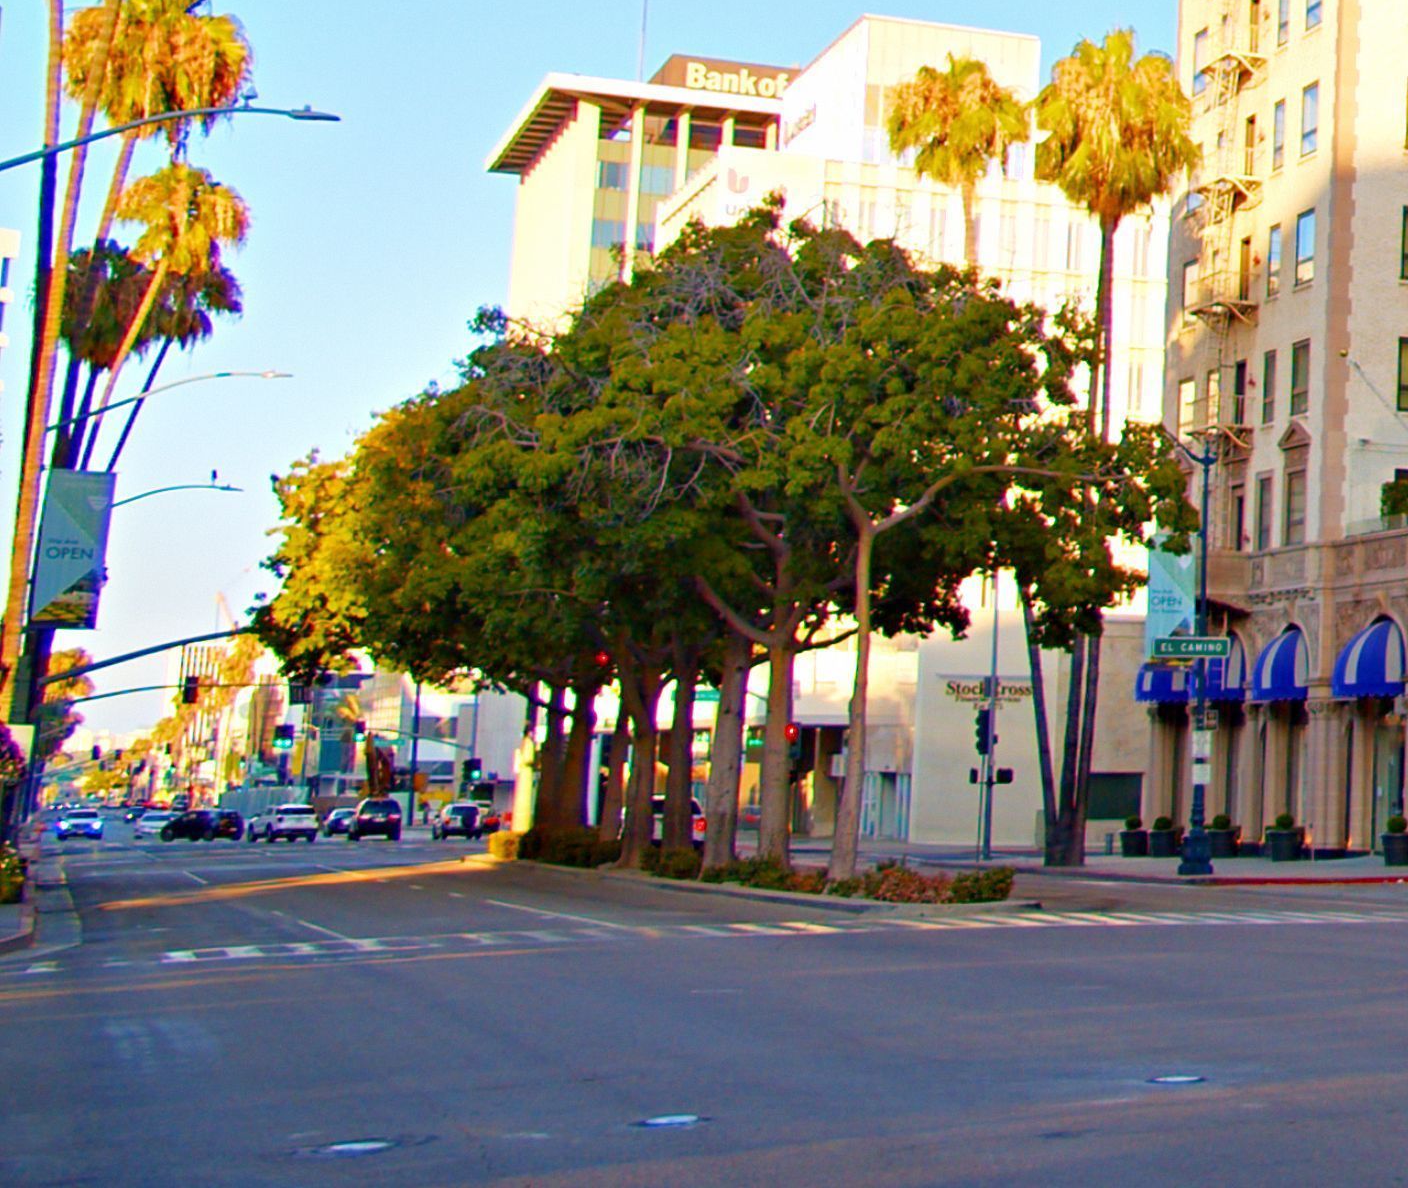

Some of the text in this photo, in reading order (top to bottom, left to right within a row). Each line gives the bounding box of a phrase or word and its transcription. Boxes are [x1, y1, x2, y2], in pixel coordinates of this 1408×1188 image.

[686, 61, 789, 98] Bank of
[46, 546, 94, 560] OPEN
[1161, 642, 1223, 653] EL CAMINO
[944, 680, 1033, 697] Stocross
